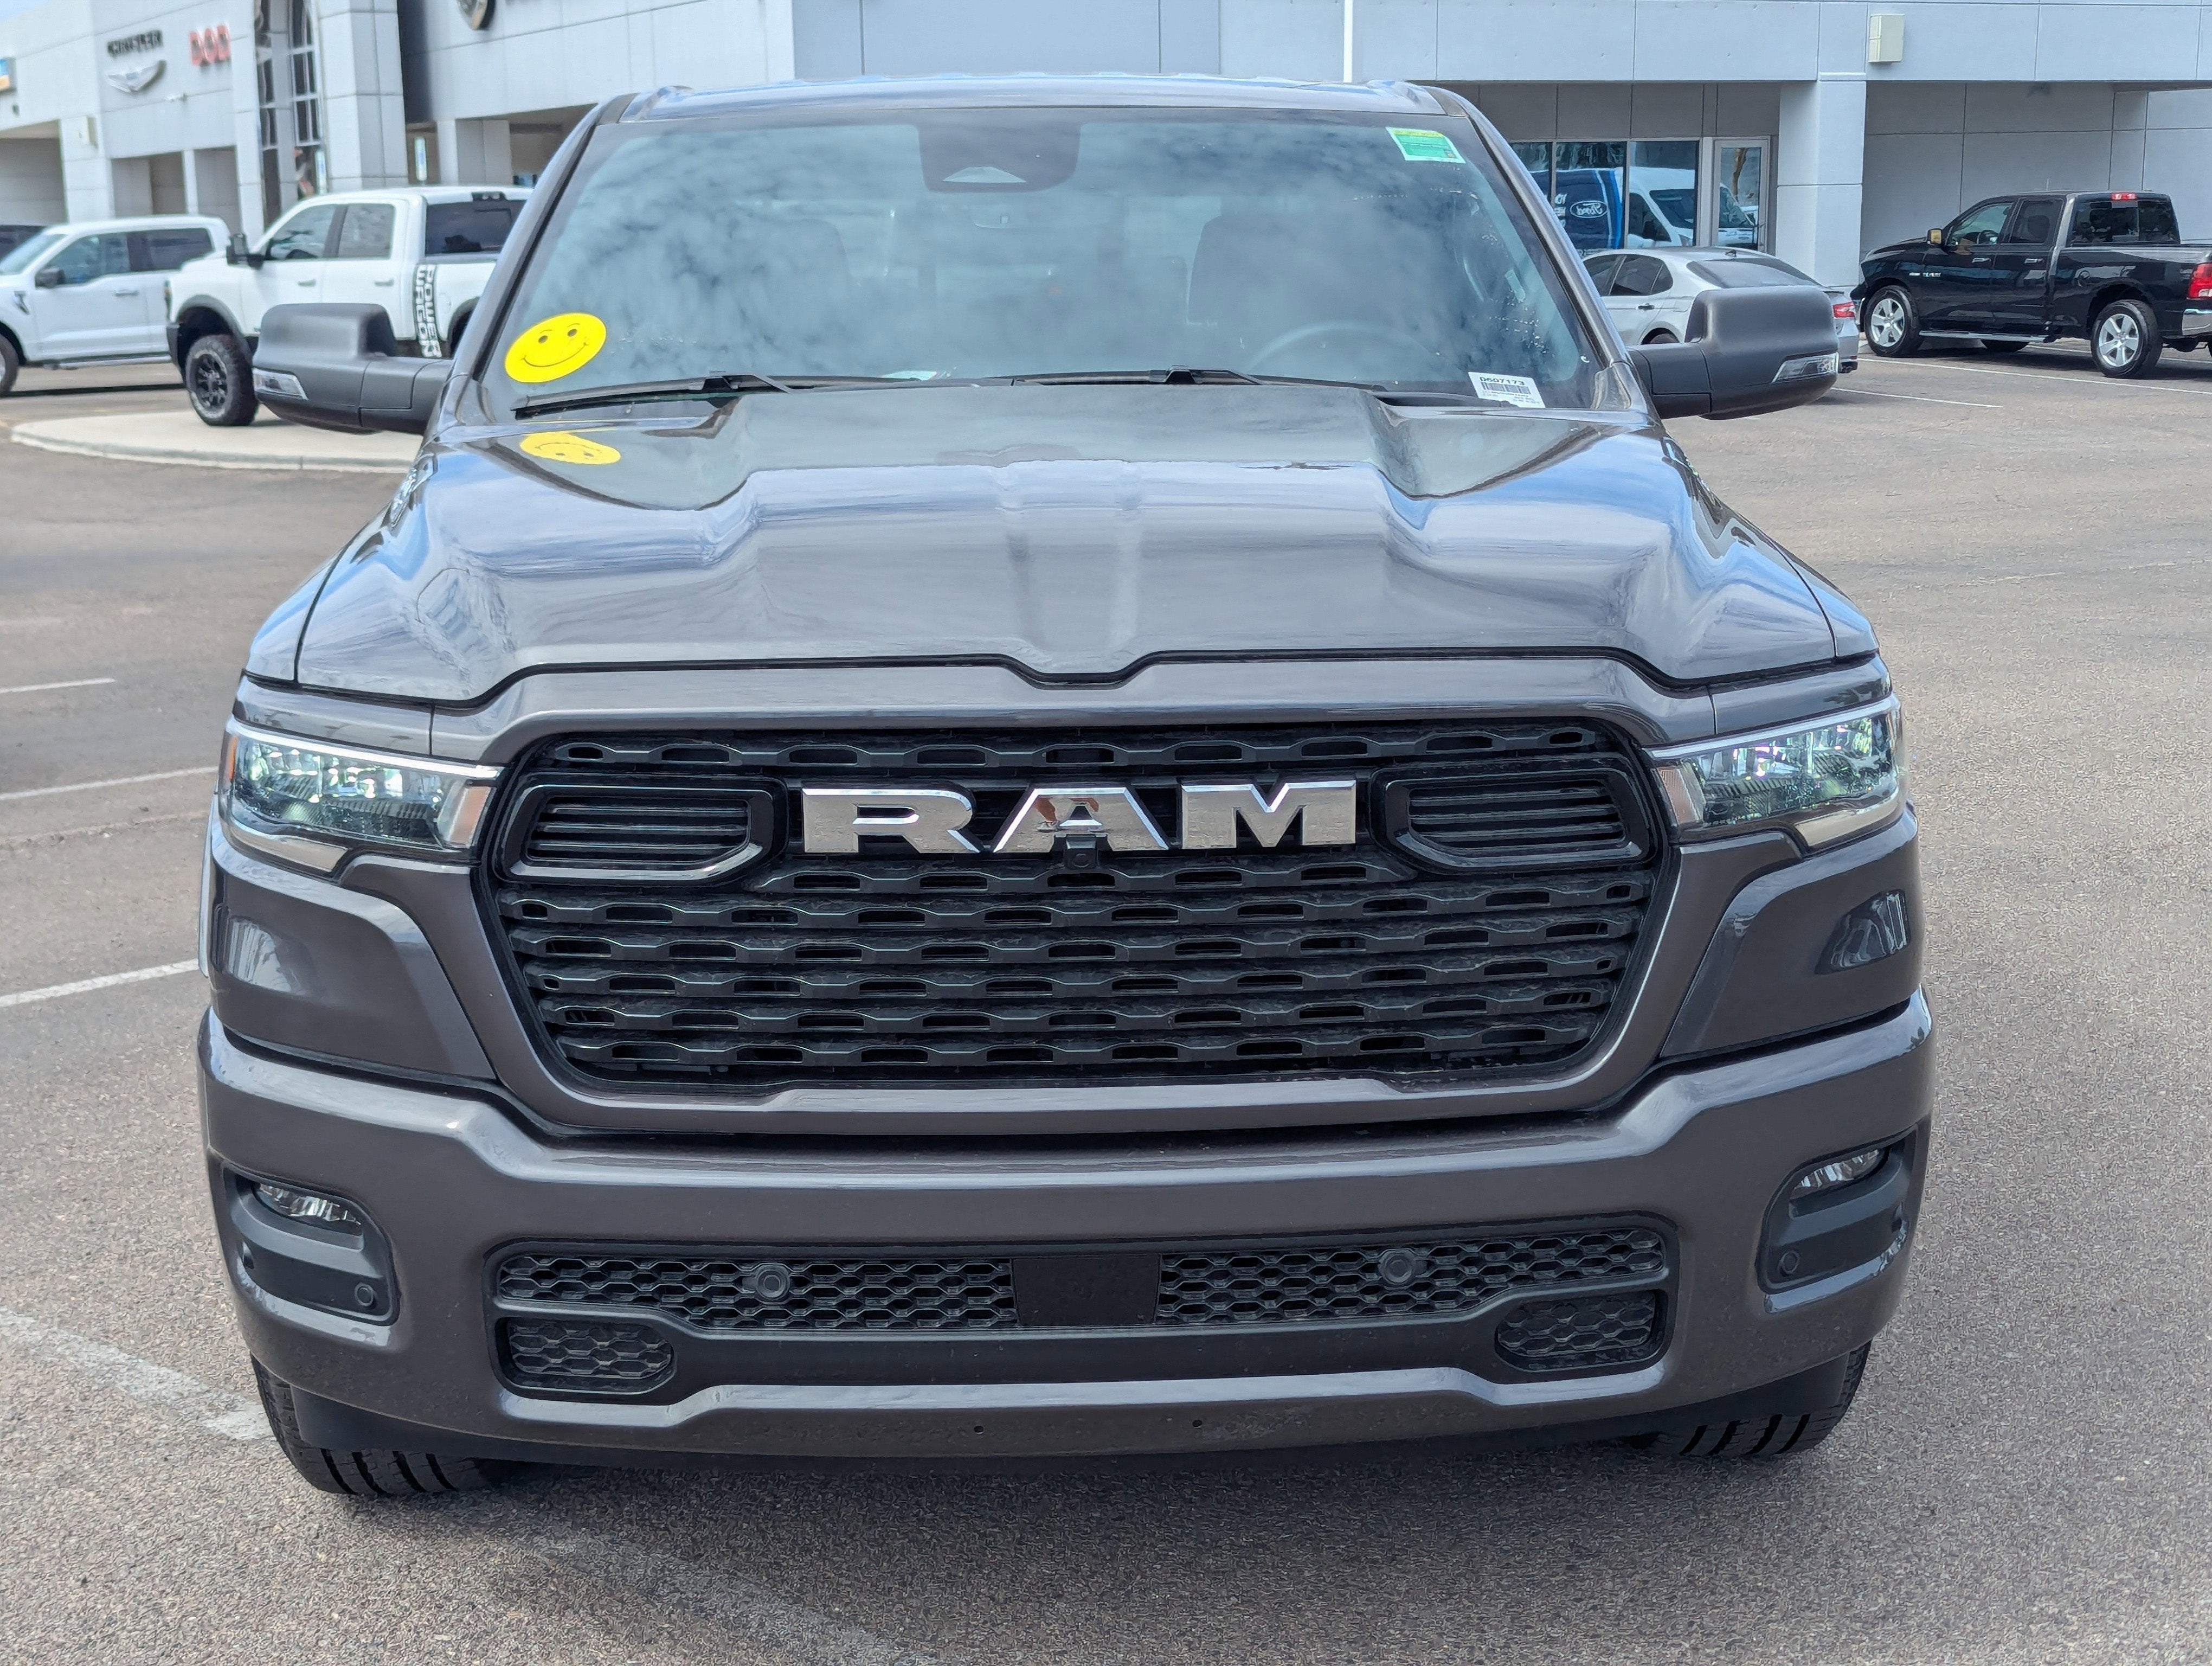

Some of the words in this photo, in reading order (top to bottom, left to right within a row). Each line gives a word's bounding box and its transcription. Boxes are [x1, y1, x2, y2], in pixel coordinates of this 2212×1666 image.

[415, 264, 434, 357] WAGON
[424, 264, 442, 357] POWER
[802, 779, 1356, 854] RAM
